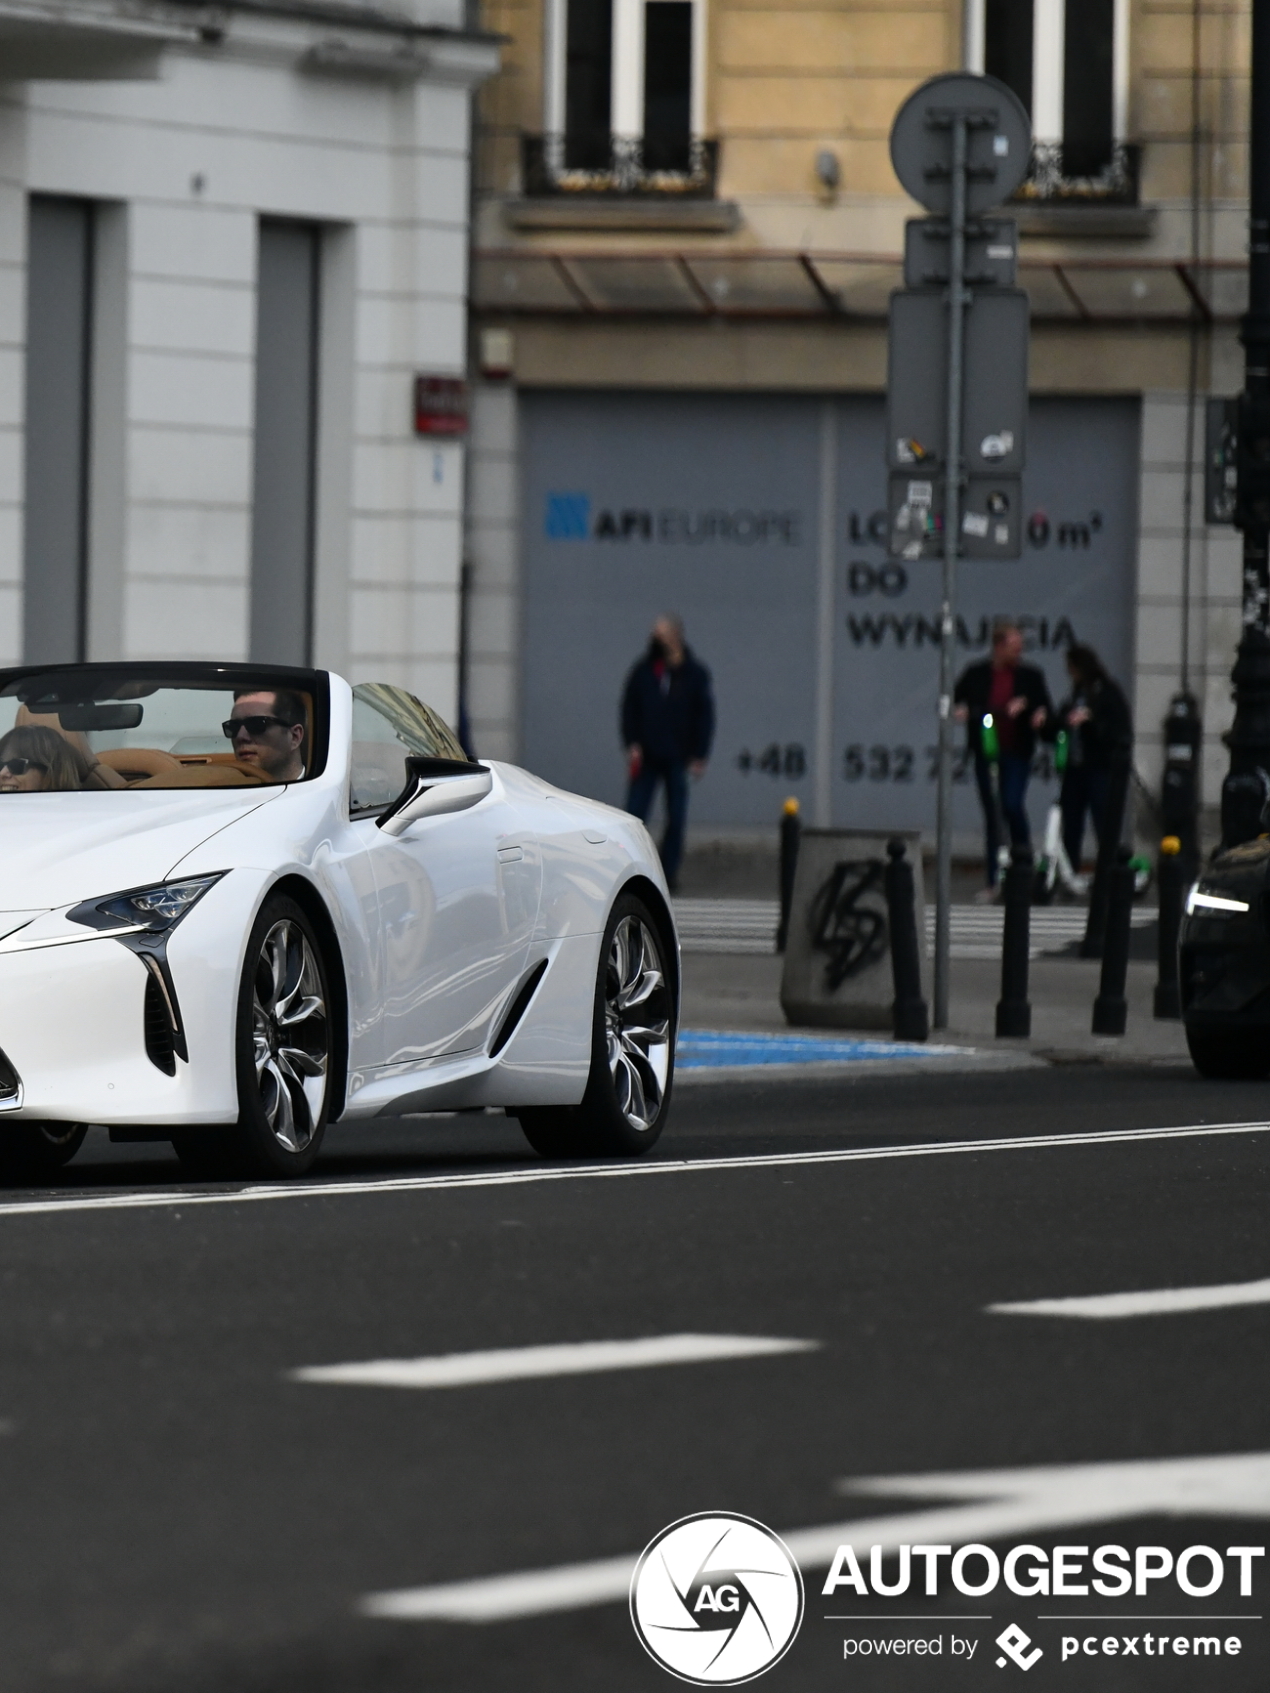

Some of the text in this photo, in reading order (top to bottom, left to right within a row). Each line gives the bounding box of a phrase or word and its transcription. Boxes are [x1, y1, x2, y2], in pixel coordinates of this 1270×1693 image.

[594, 508, 802, 546] AFI EUROPE
[847, 561, 908, 597] DO
[847, 612, 1076, 650] WYNAJCIA
[736, 741, 808, 781] +48
[843, 742, 915, 785] 532
